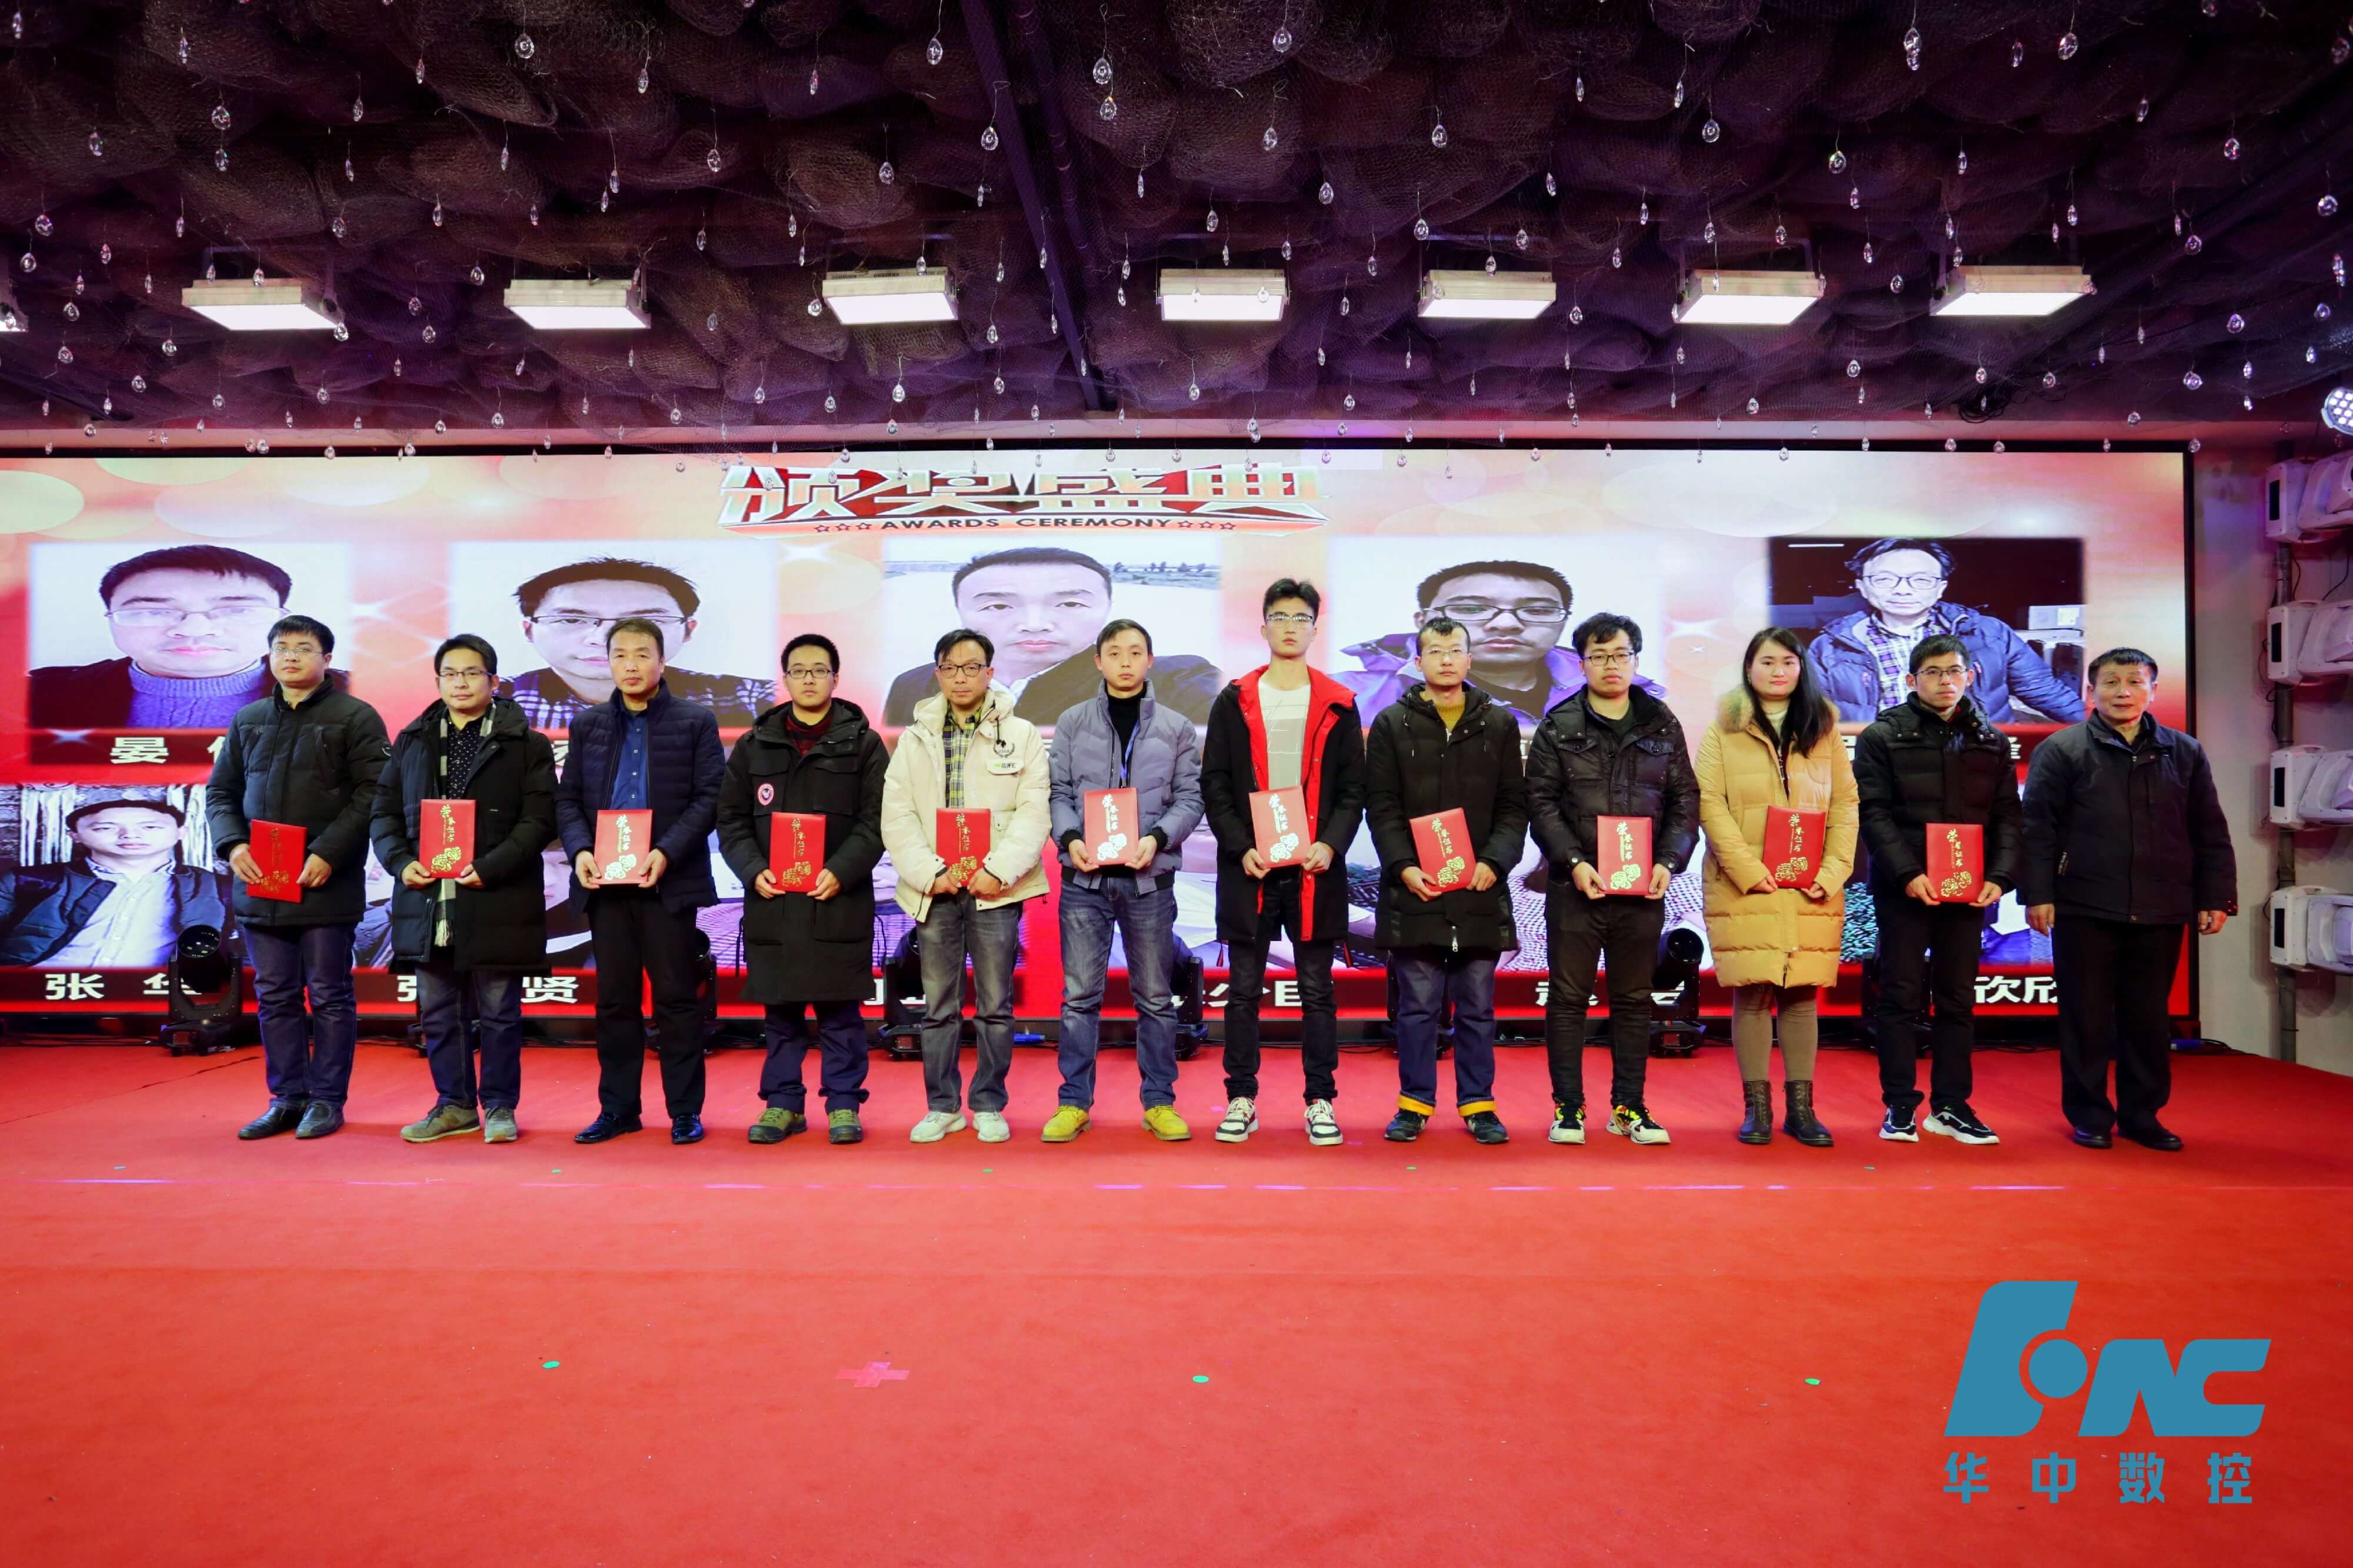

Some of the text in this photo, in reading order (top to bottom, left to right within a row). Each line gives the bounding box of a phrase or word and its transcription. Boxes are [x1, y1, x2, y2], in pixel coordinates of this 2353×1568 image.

[718, 462, 1331, 525] 颁奖盛典
[881, 518, 1171, 529] AWARDS CEREMONY
